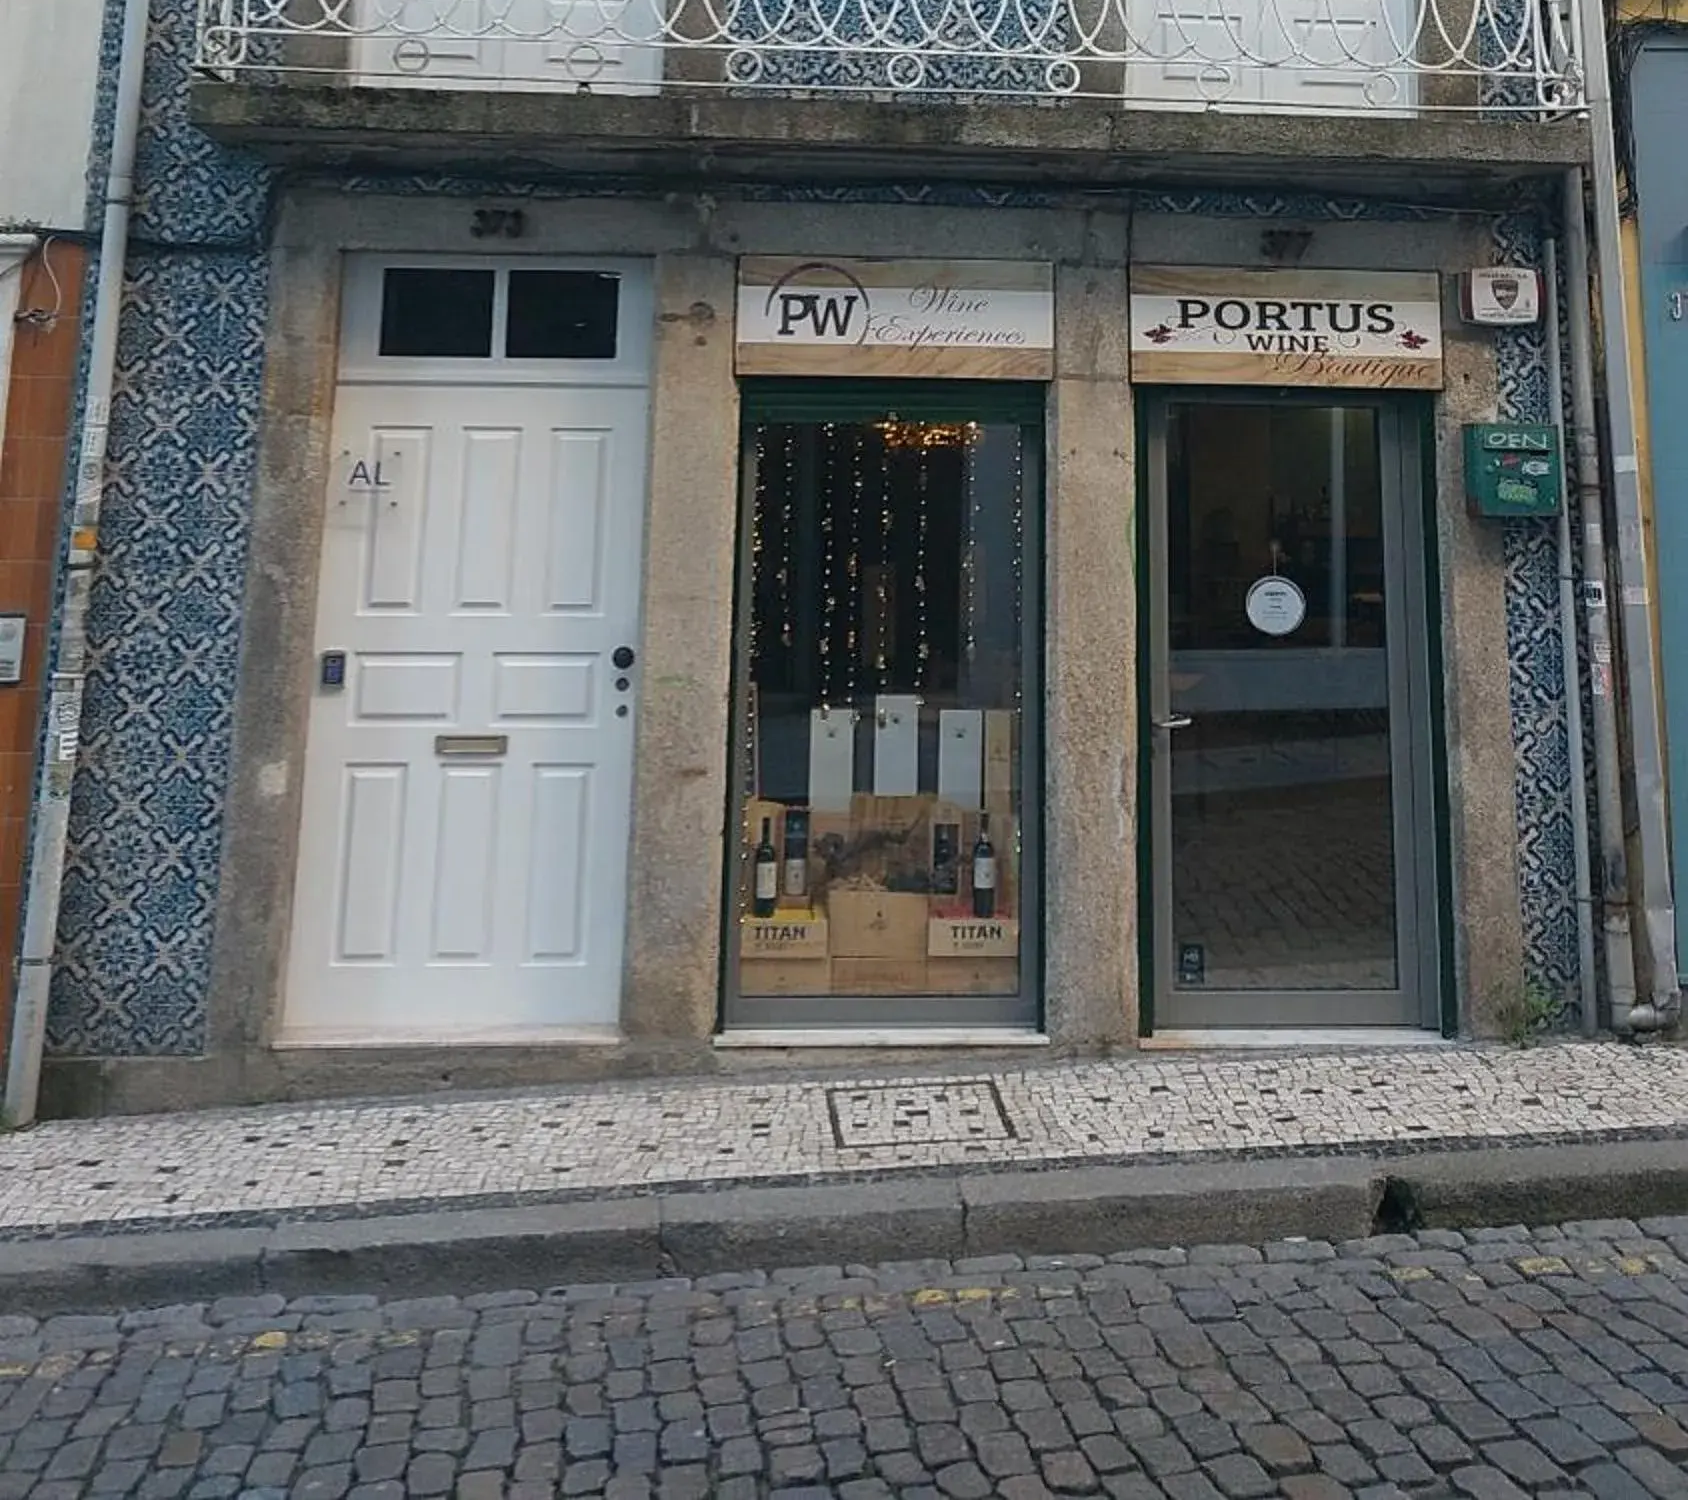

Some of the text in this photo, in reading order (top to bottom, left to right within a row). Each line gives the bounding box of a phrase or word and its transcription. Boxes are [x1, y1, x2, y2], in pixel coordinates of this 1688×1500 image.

[1260, 229, 1313, 261] 377
[909, 282, 990, 314] Wine
[777, 294, 858, 337] PW
[1176, 298, 1396, 334] PORTUS
[1245, 333, 1329, 353] WINE
[1271, 350, 1432, 387] Boutique
[348, 460, 391, 485] AL
[752, 926, 806, 940] TITAN
[951, 925, 1002, 940] TITAN
